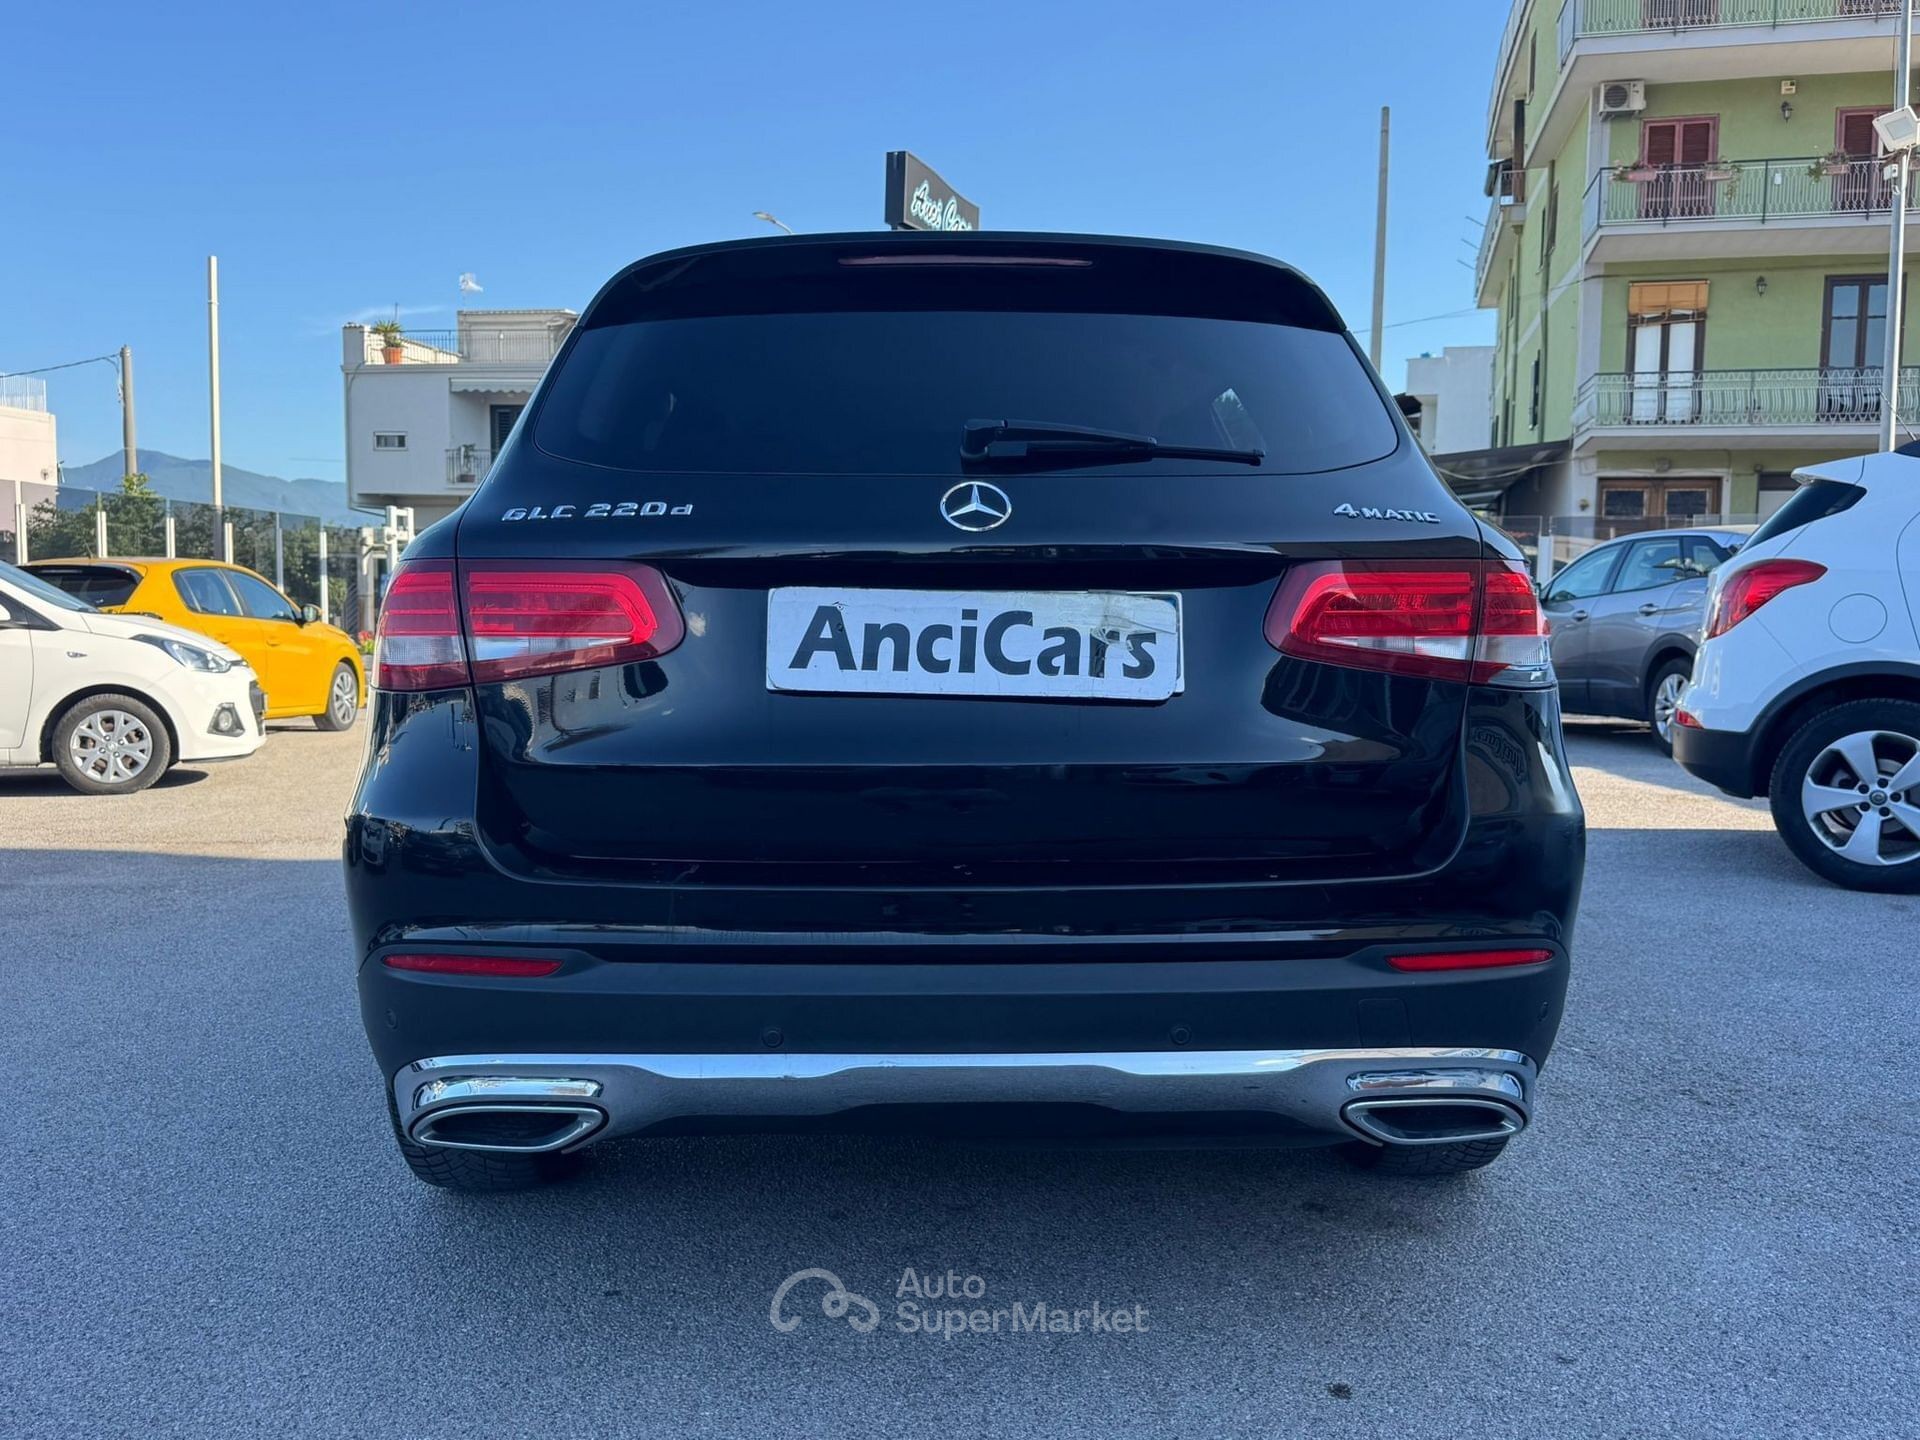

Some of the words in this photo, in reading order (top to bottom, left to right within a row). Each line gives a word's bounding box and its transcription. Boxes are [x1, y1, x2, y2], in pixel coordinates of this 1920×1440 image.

[502, 505, 577, 521] GLC
[584, 501, 694, 517] 220d
[1333, 503, 1441, 524] 4MATIC
[788, 604, 1157, 680] AnciCars
